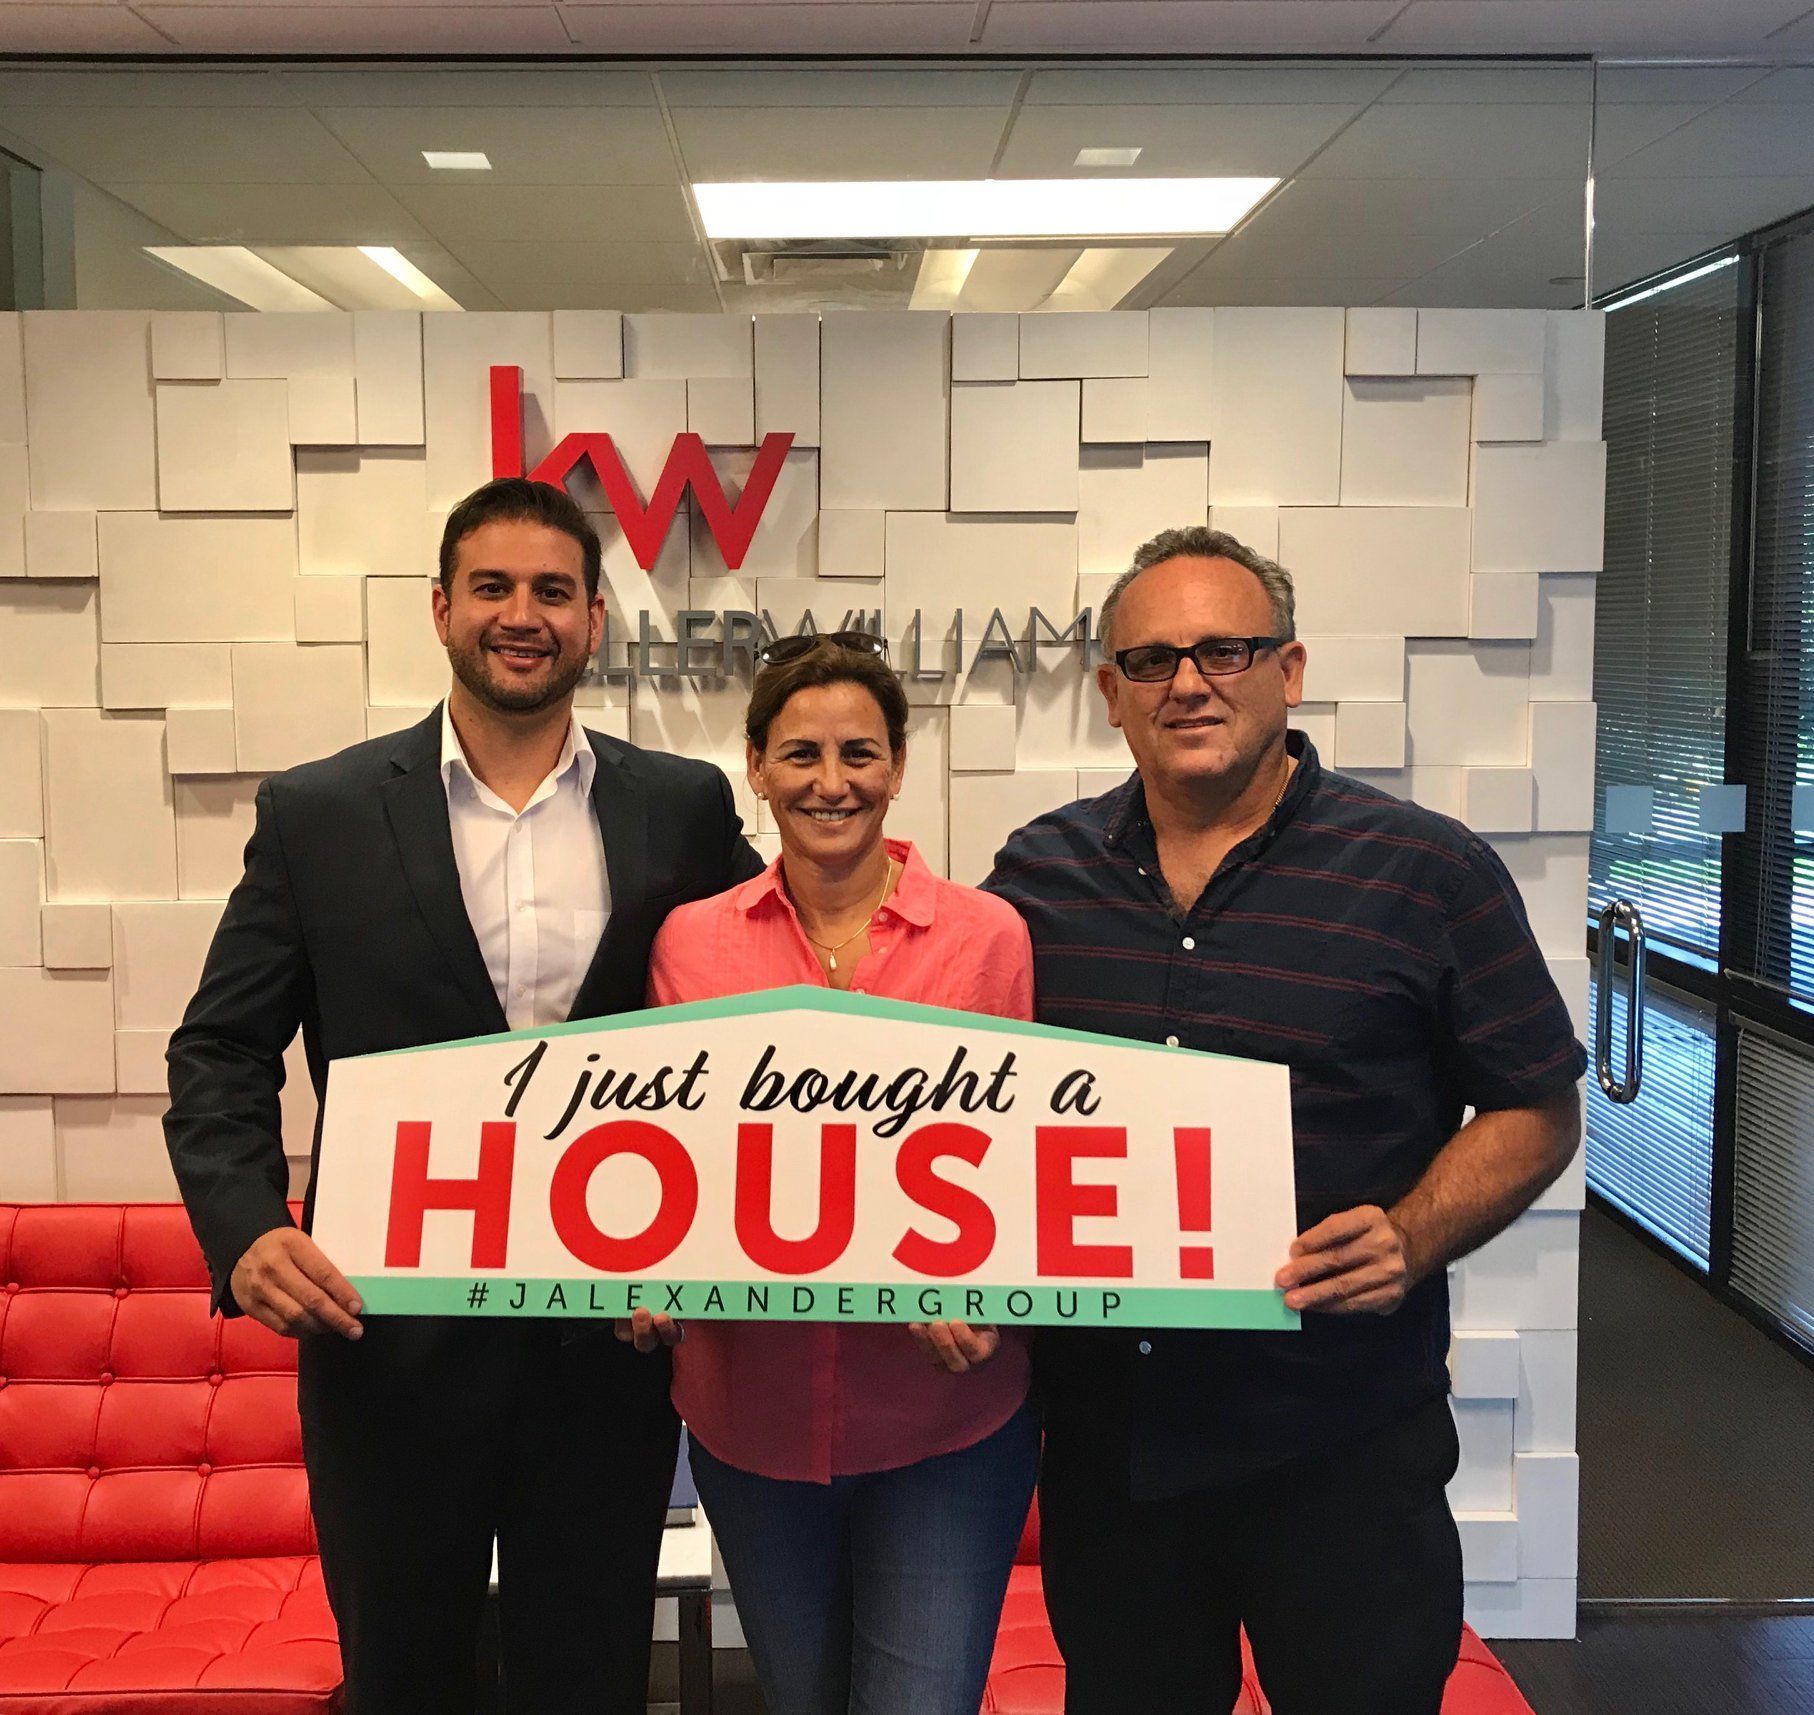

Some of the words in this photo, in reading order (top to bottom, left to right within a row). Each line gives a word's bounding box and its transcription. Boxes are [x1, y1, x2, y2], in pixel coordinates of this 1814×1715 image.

[489, 365, 796, 570] kw
[503, 1040, 549, 1118] I
[543, 1049, 709, 1140] just
[739, 1043, 1018, 1138] bought
[1050, 1068, 1102, 1116] a
[384, 1119, 1215, 1280] HOUSE!
[467, 1282, 1122, 1319] #JALEXANDERGROUP
